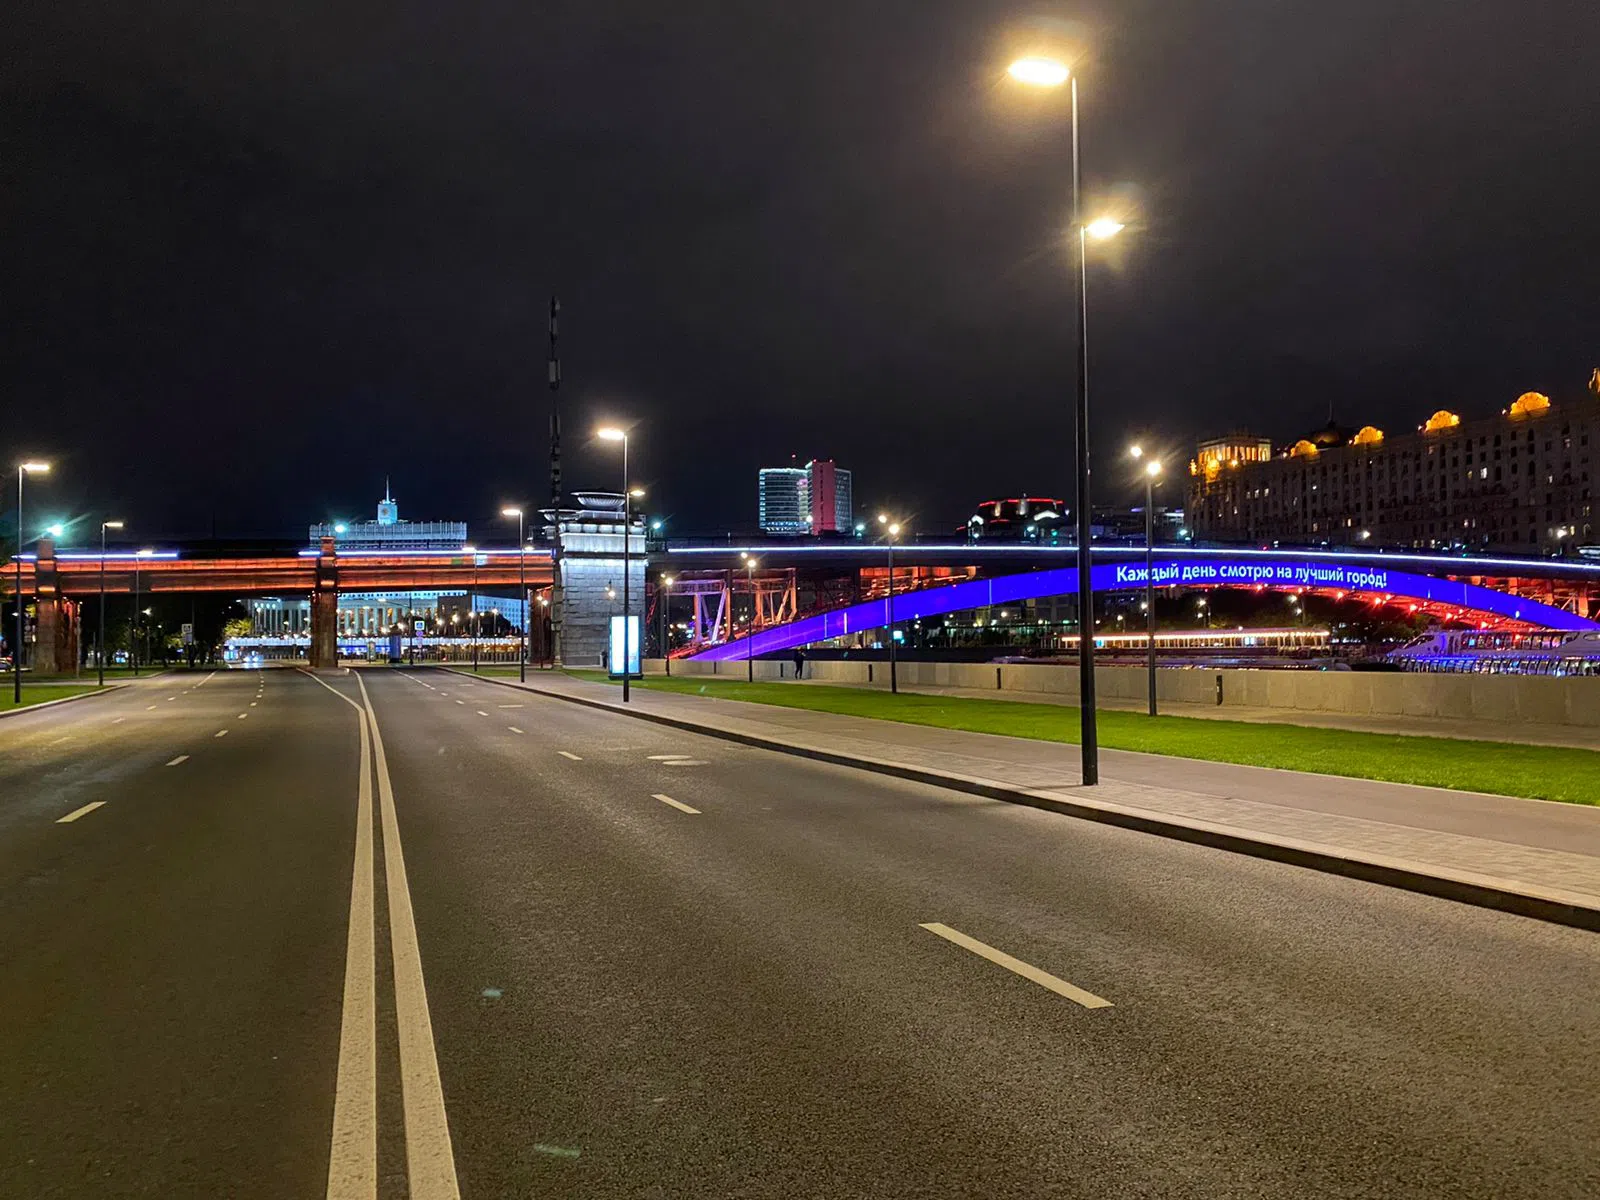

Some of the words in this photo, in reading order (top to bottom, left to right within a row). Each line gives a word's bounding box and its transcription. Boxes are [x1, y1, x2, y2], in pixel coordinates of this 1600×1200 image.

[1116, 563, 1179, 582] Каждый
[1182, 565, 1217, 581] день
[1219, 566, 1274, 582] смотрю
[1277, 566, 1292, 579] на
[1295, 567, 1344, 583] лучший
[1347, 571, 1387, 588] город!
